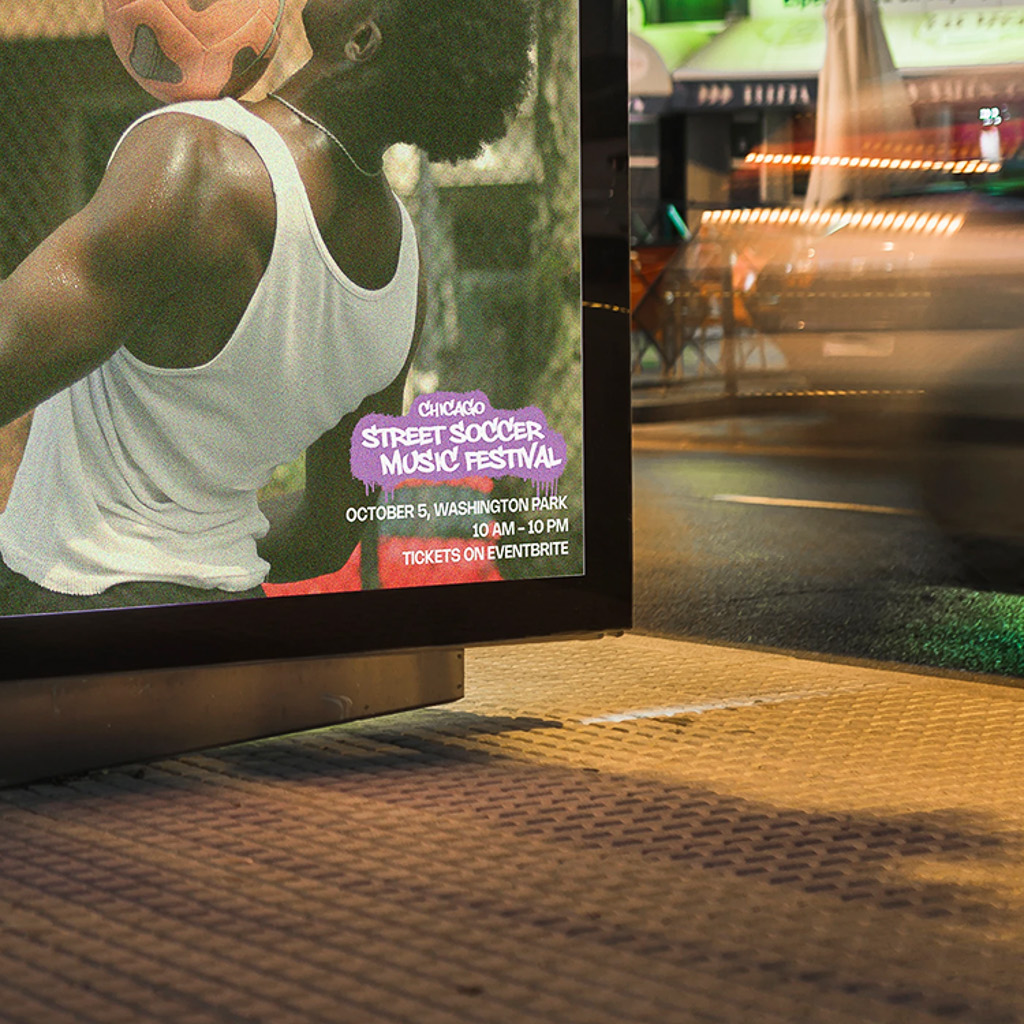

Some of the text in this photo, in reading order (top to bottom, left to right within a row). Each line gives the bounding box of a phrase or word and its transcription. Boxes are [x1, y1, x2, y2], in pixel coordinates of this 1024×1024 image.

[418, 398, 486, 417] CHICAGO
[361, 417, 546, 449] STREET SOCCER
[379, 441, 562, 476] MUSIC FESTIVAL
[346, 495, 568, 522] OCTOBER 5, WASHINGTON PARK
[472, 523, 489, 538] 10
[491, 521, 515, 536] AM
[528, 520, 544, 534] 10
[547, 518, 569, 533] PM
[402, 541, 569, 565] TICKETS ON EVENTBRITE
